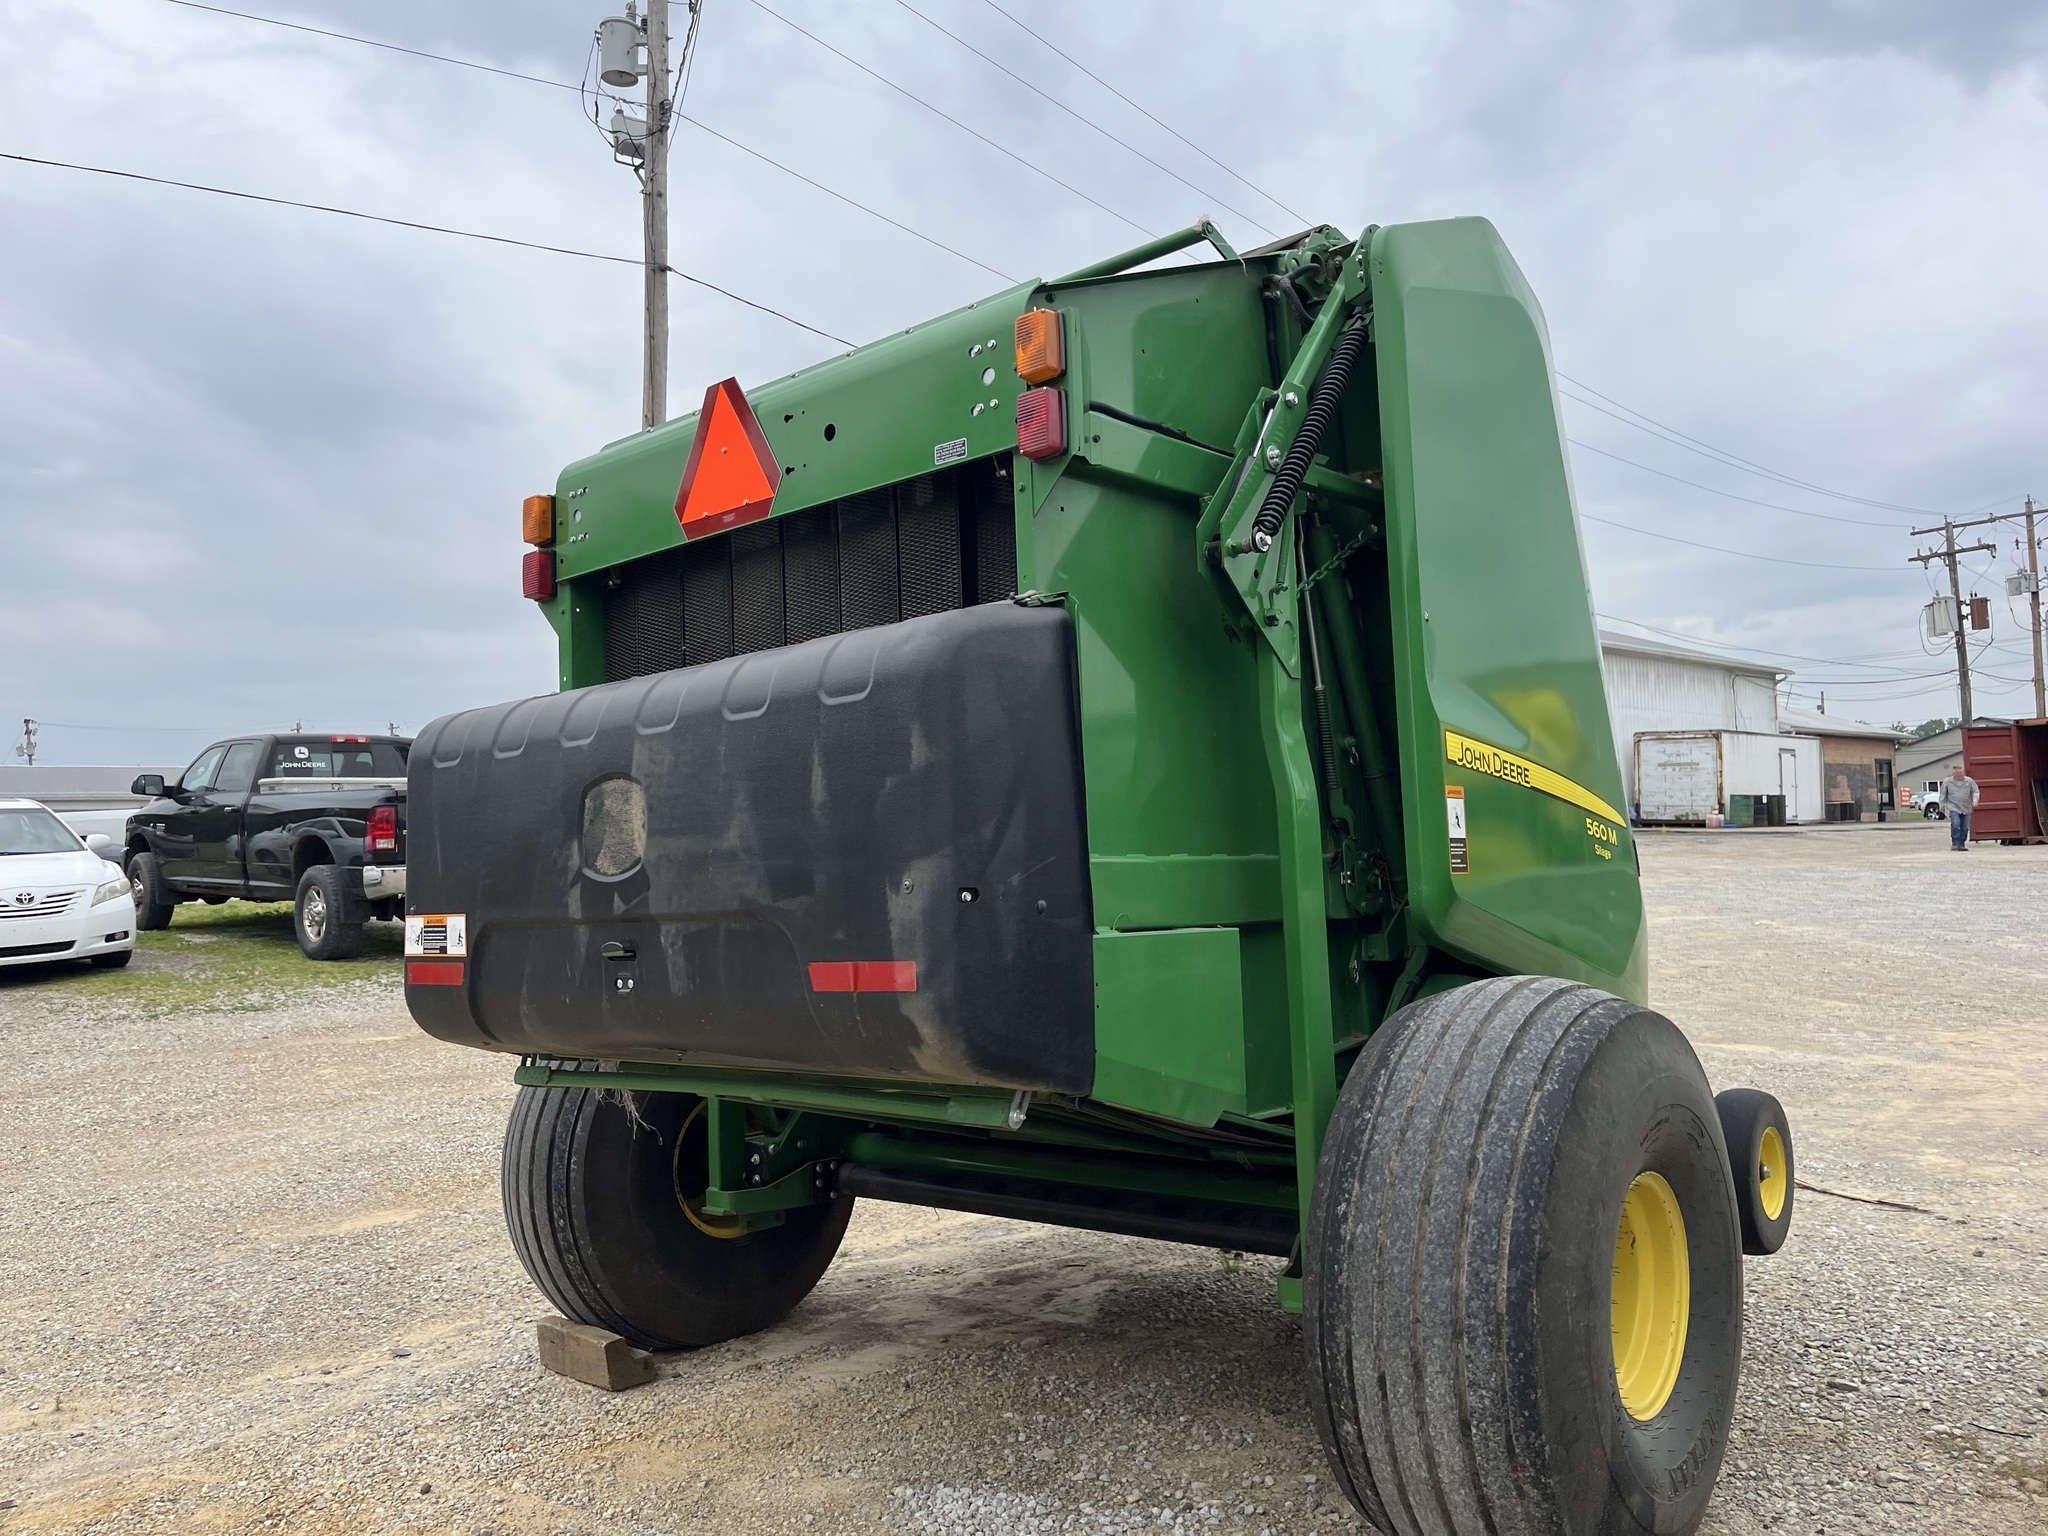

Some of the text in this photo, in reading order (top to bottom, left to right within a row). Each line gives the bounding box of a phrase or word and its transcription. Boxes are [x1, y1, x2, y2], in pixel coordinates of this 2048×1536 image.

[1457, 742, 1531, 785] JOHN DEERE
[1586, 817, 1618, 846] 560 M
[1594, 843, 1612, 860] Silage
